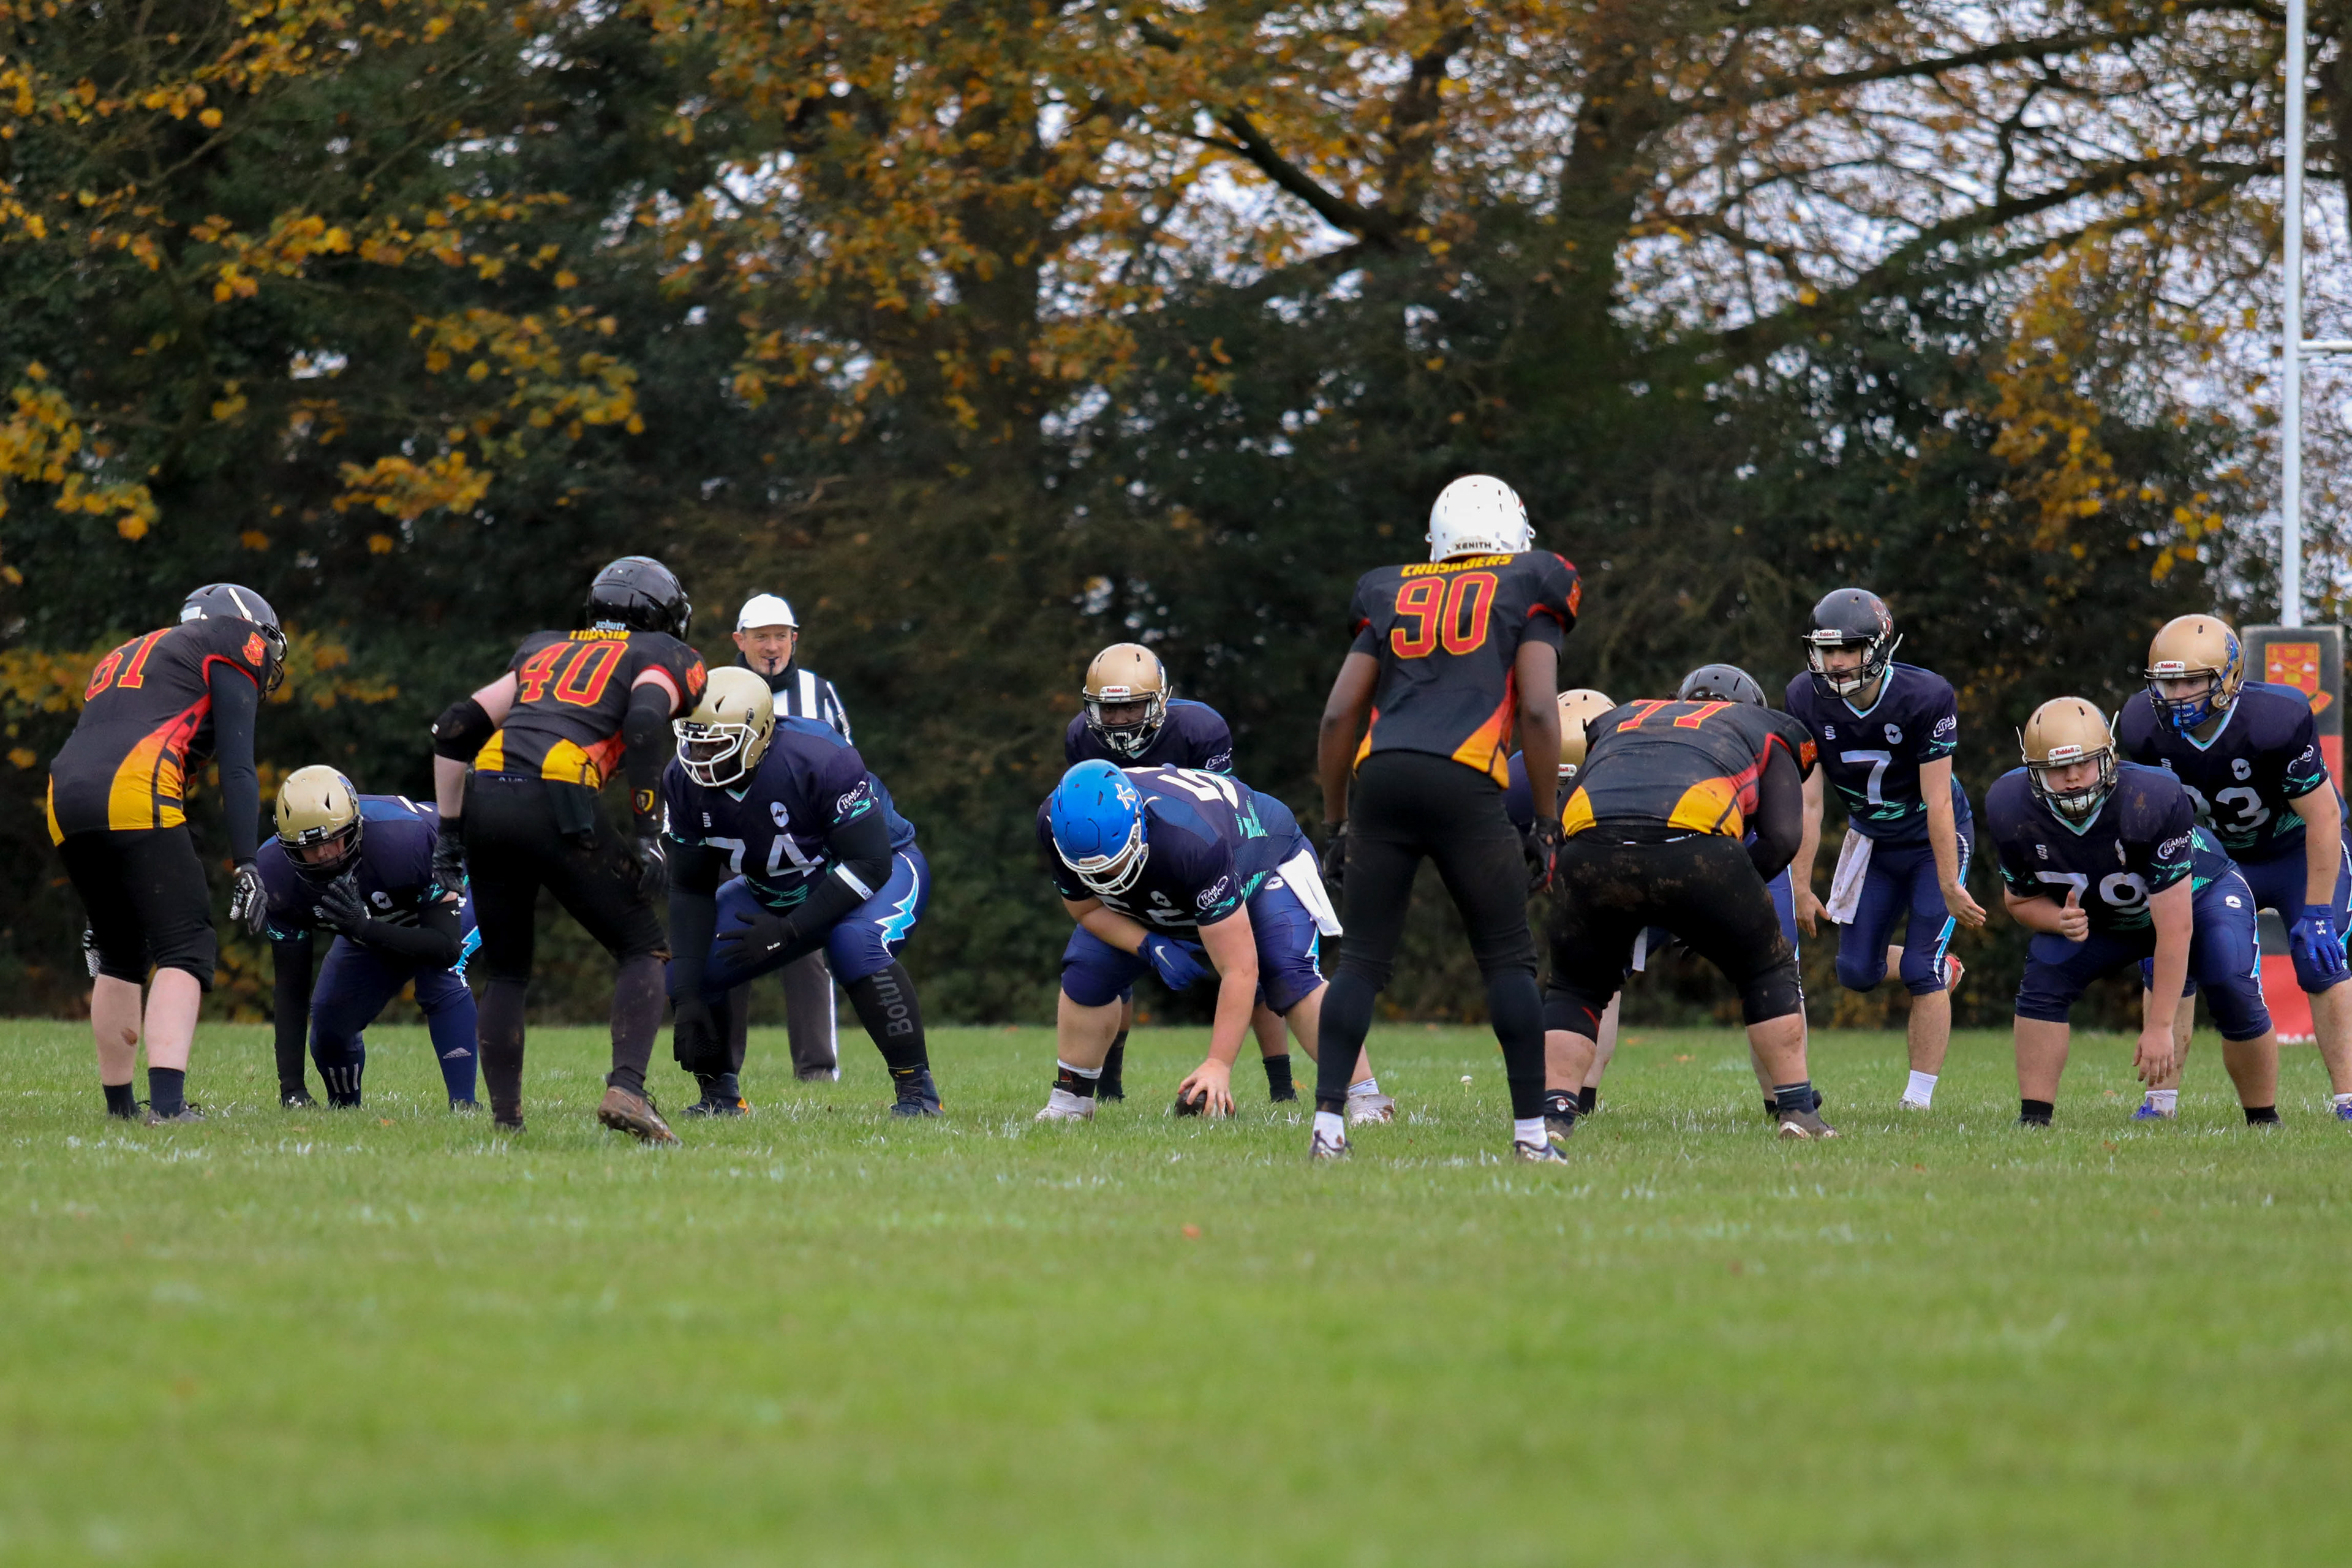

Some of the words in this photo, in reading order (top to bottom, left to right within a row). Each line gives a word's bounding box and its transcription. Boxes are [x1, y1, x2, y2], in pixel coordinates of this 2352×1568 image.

[1455, 541, 1492, 551] XENITH
[1391, 572, 1498, 659] 90
[519, 640, 629, 707] 40
[2055, 747, 2075, 756] Riddell
[1841, 750, 1893, 805] 7
[705, 833, 825, 878] 74
[1201, 885, 1218, 902] TEAM
